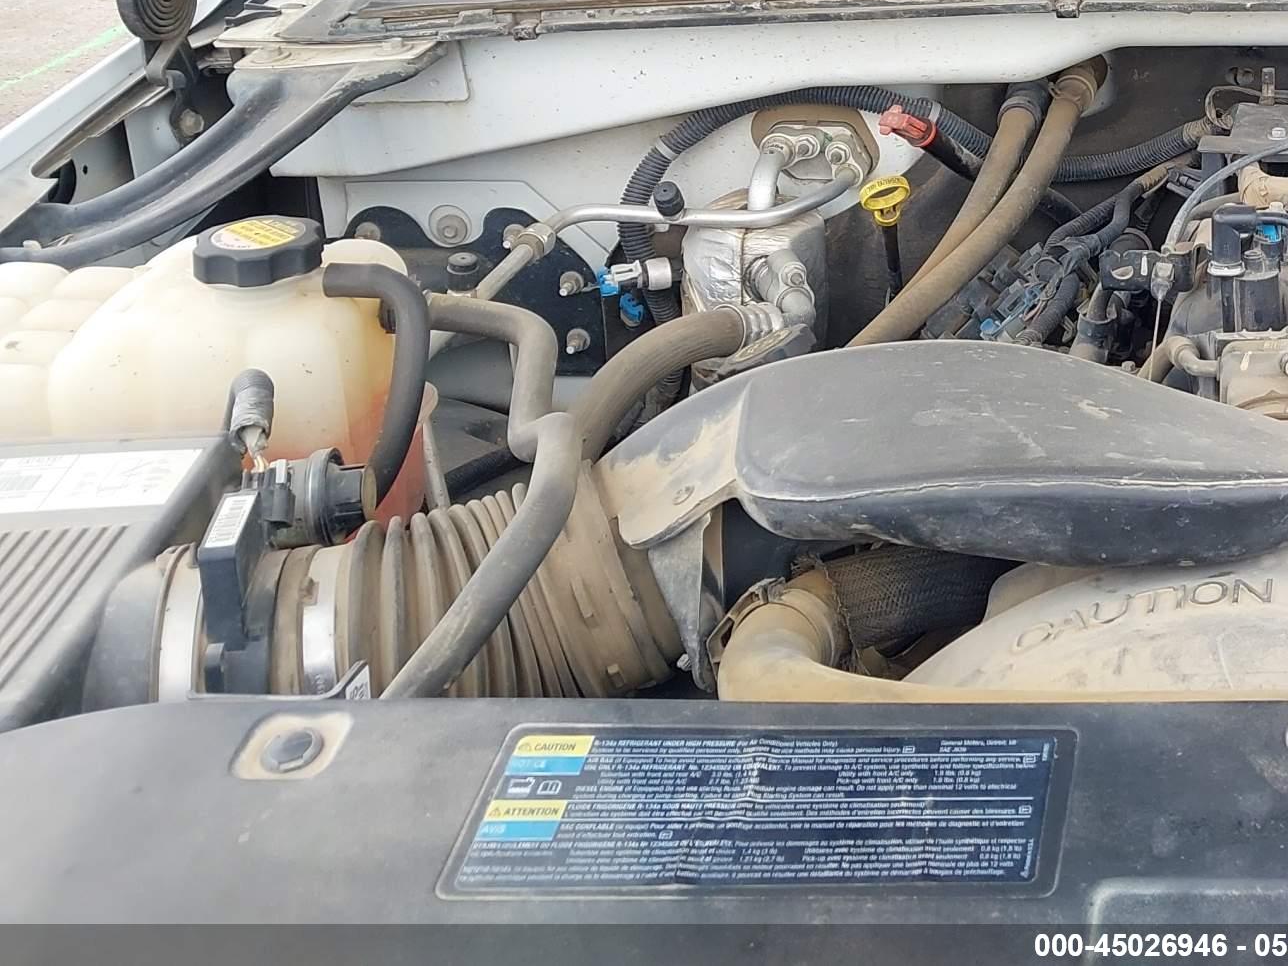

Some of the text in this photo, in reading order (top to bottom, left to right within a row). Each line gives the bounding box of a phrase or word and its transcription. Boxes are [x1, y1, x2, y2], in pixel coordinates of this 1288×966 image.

[1013, 577, 1274, 653] CAUTION
[534, 742, 576, 752] CAUTION
[504, 807, 559, 816] ATTENTION
